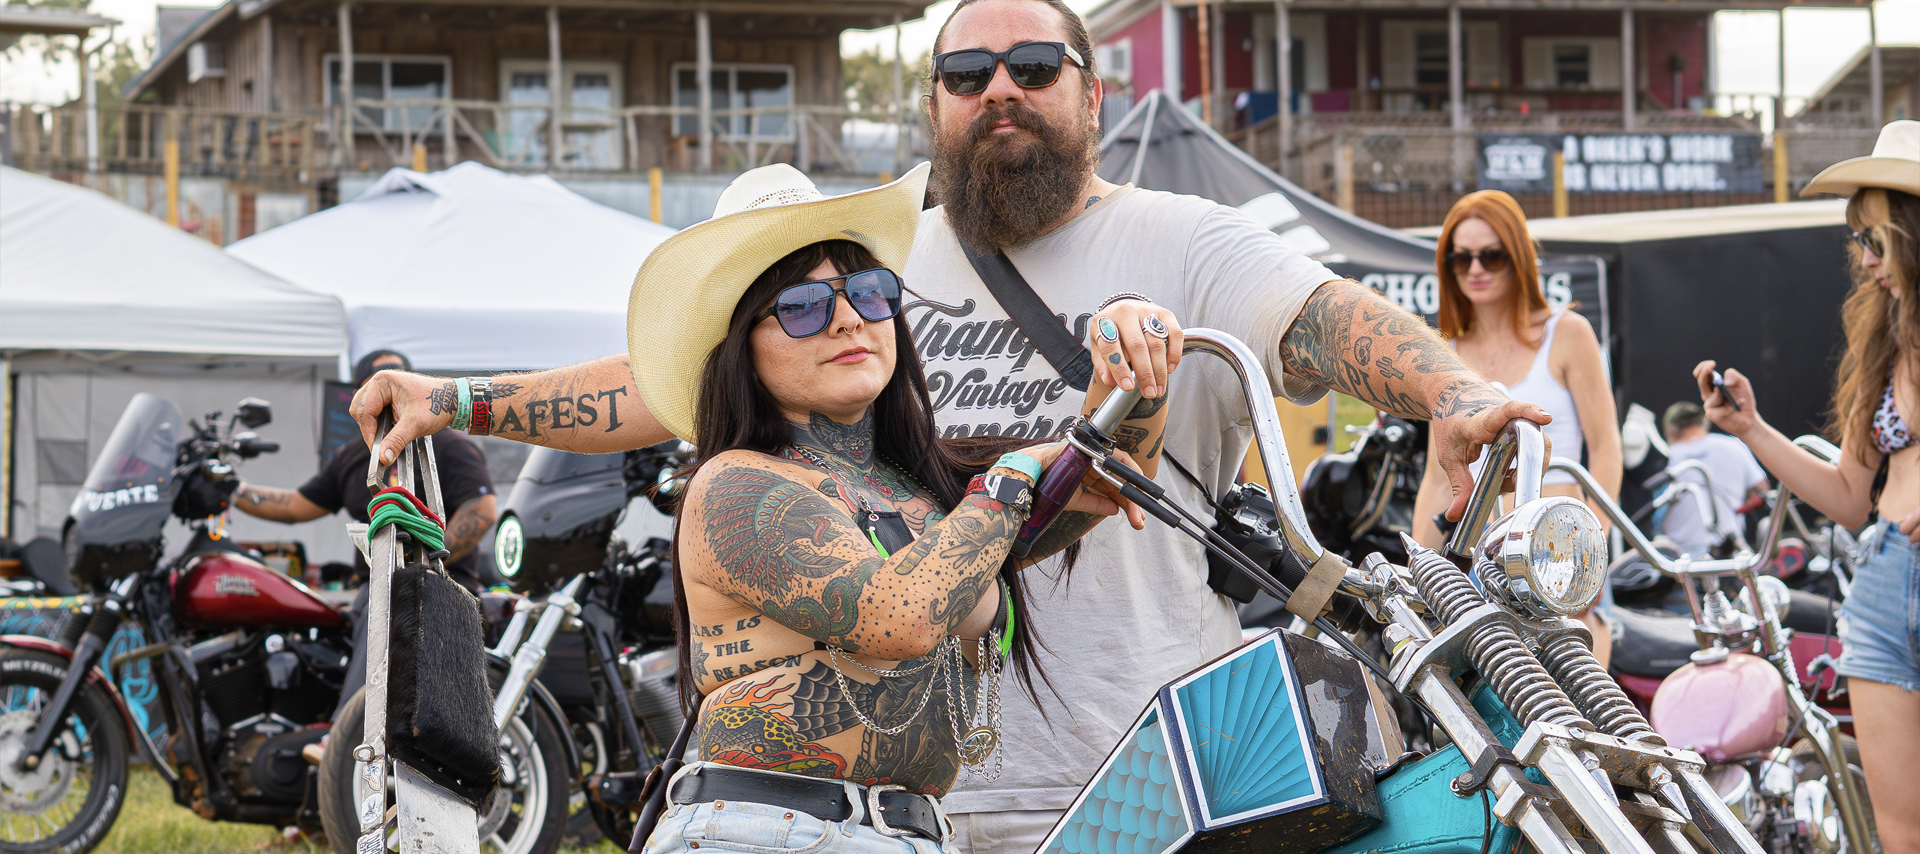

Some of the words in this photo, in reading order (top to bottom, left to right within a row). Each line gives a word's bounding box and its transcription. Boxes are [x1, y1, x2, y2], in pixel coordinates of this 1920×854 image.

[1583, 135, 1665, 163] BIKER'S
[1670, 135, 1733, 163] WORK
[1590, 163, 1659, 191] NEVER
[1663, 163, 1727, 191] DONE.
[926, 367, 1068, 418] Vintage
[491, 385, 628, 437] AFEST
[735, 615, 762, 632] IS
[713, 639, 754, 657] THE
[712, 654, 802, 682] REASON
